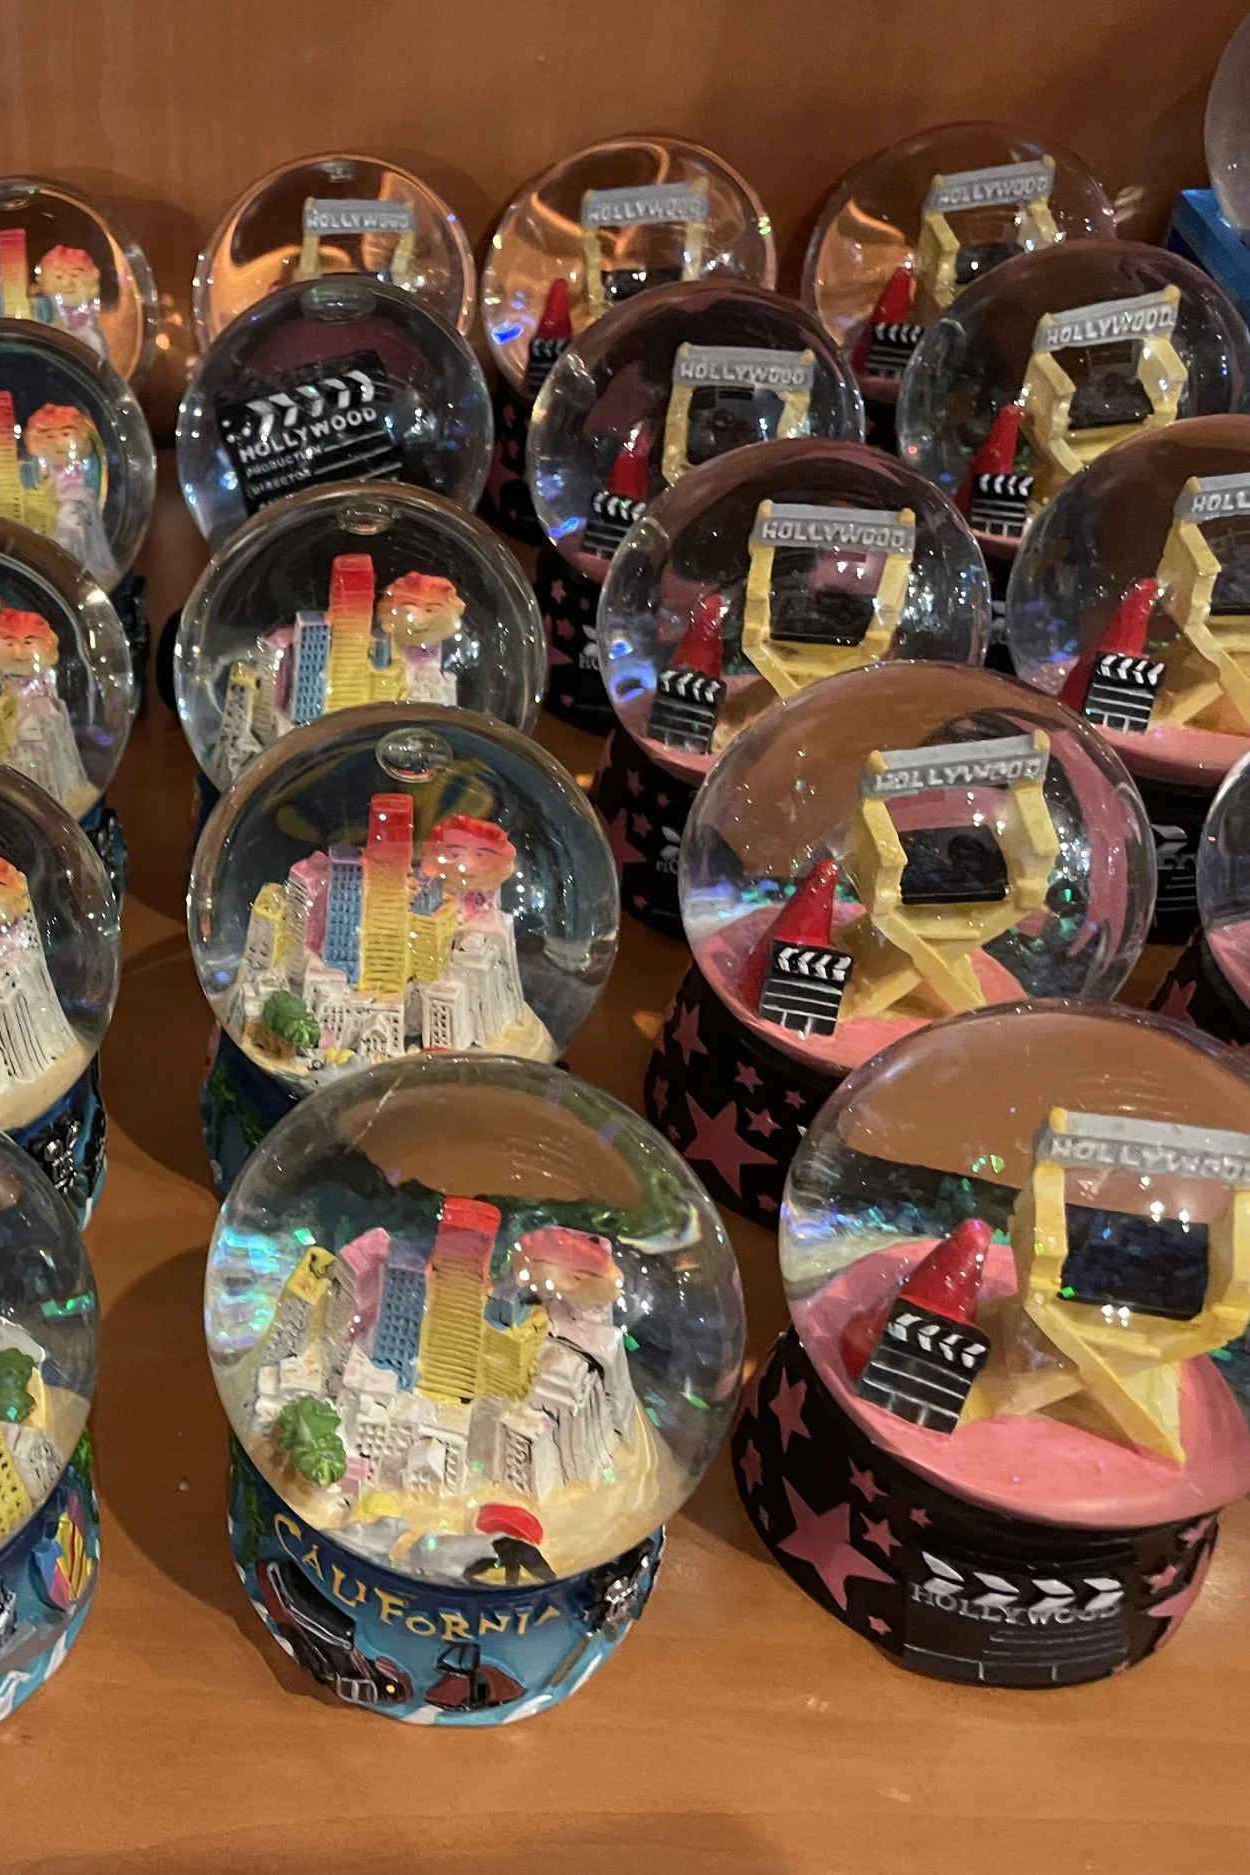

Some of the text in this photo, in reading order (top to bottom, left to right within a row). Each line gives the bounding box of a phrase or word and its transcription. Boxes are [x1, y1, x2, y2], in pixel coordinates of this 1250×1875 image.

[1048, 304, 1173, 343] HOLLYWOOD
[680, 362, 805, 385] HOLLYWOOD
[239, 407, 377, 463] HOLLYWOOD
[761, 521, 906, 548] HOLLYWOOD
[875, 758, 1041, 792] HOLLYWOOD
[274, 1513, 560, 1642] CALIFORNIA
[910, 1581, 1122, 1627] HOLLYWOOD
